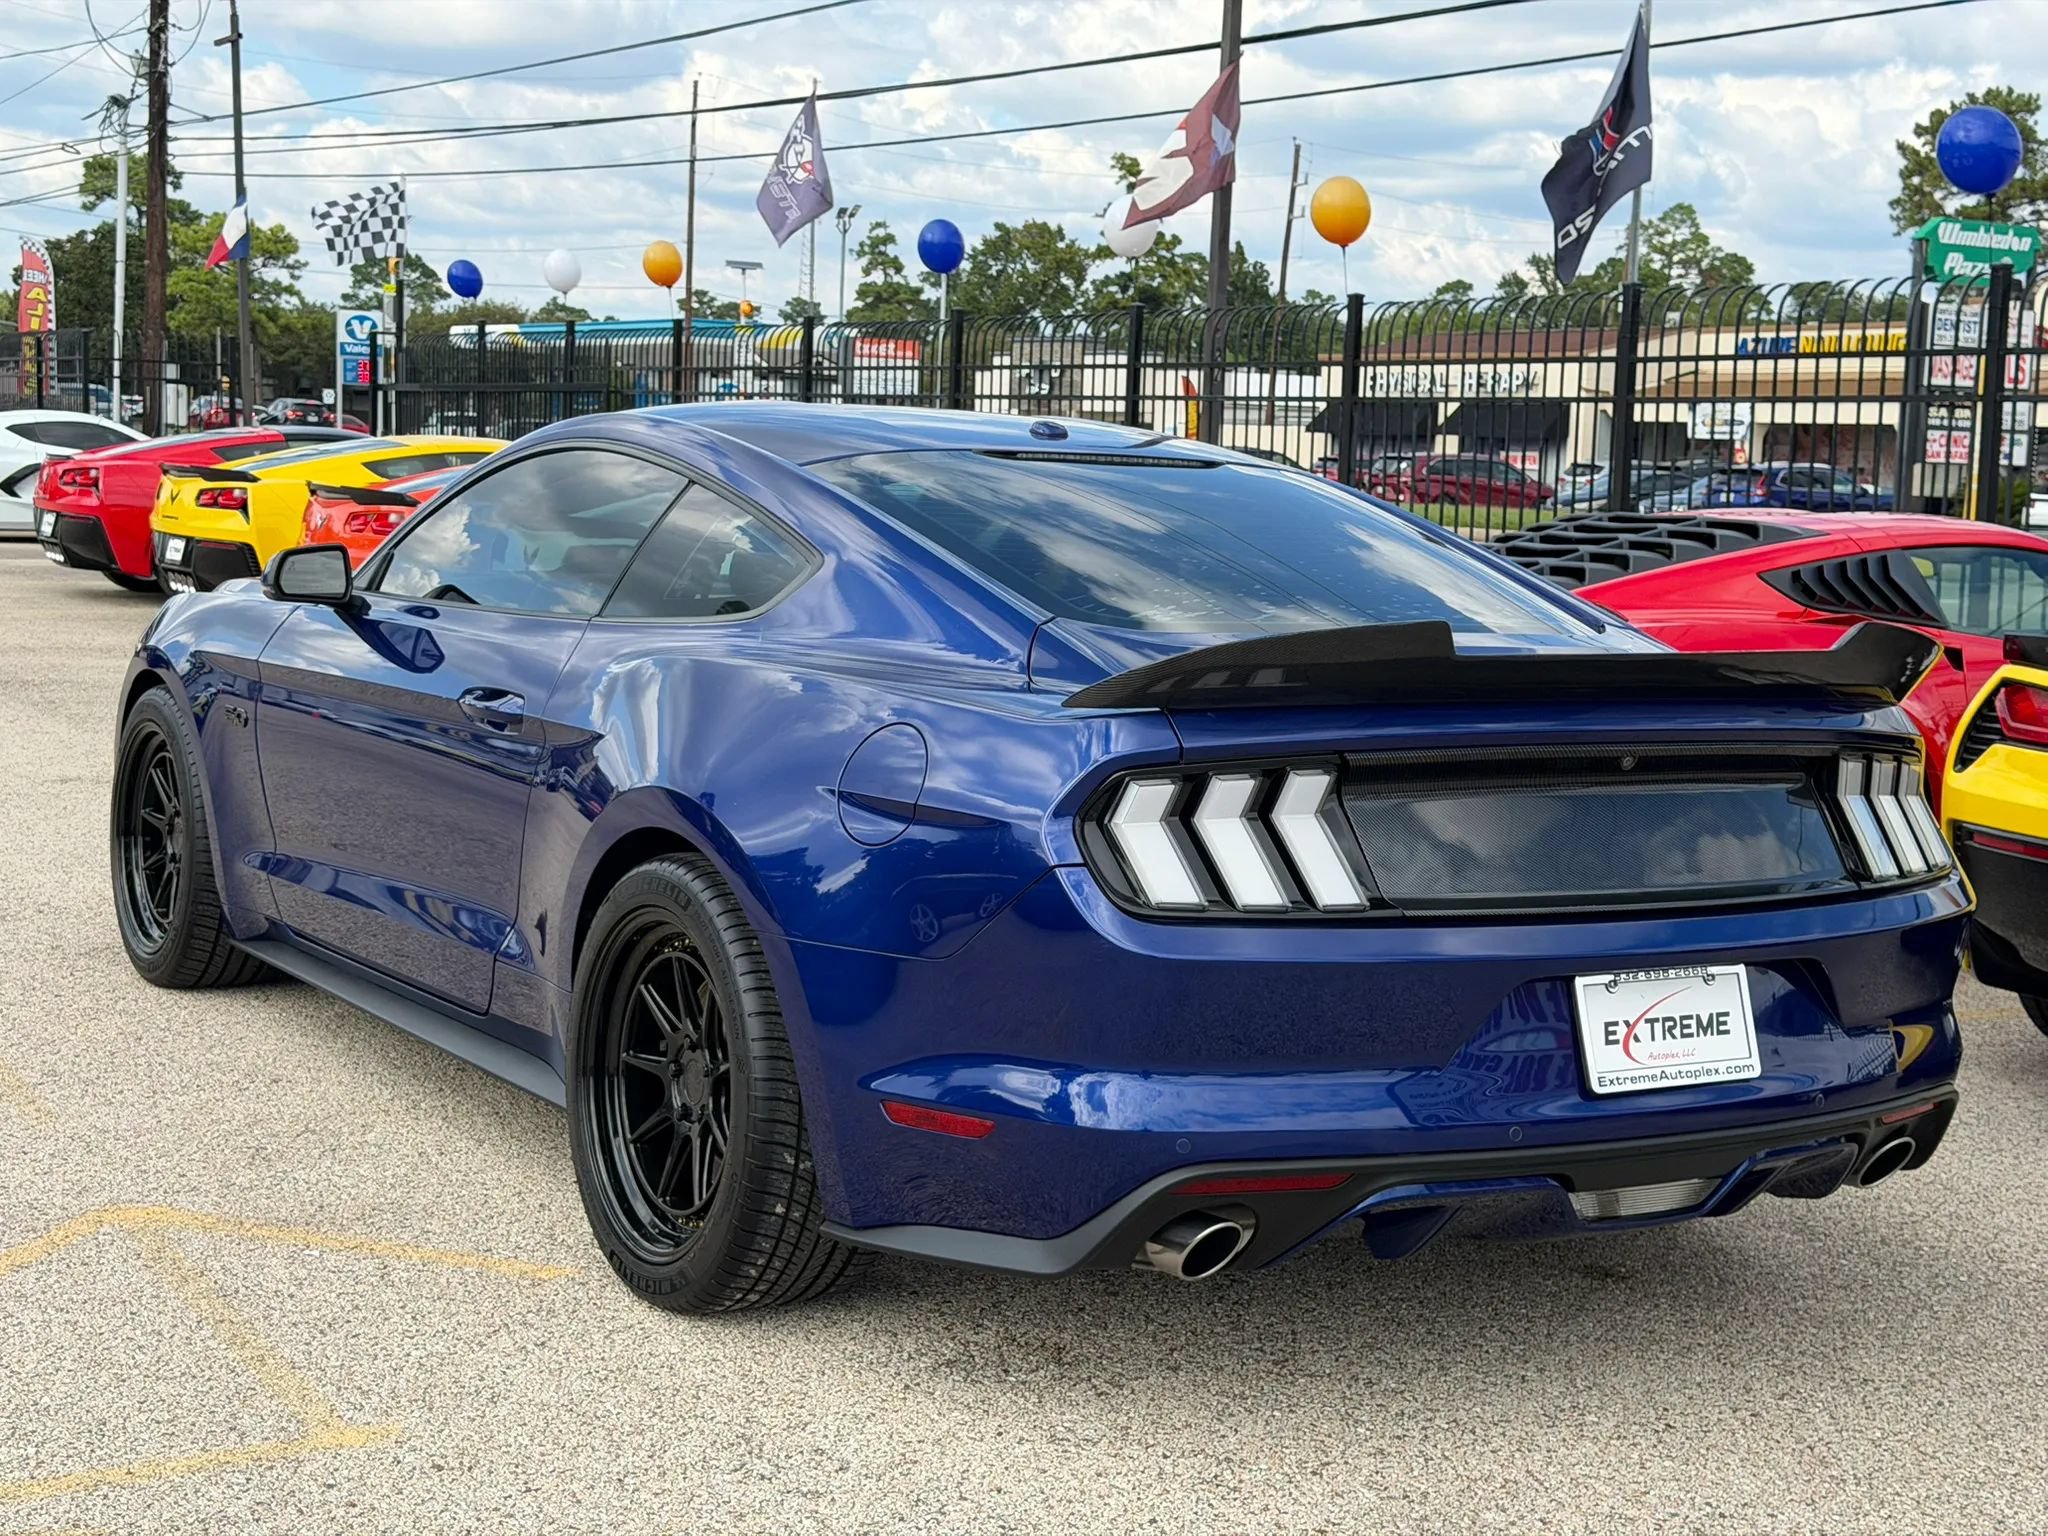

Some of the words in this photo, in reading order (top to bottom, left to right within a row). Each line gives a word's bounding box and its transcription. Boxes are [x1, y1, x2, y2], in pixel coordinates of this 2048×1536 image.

[1937, 221, 2032, 252] Wimbledon
[1937, 317, 1979, 335] DENIST
[1931, 354, 1976, 380] MASAGE
[1604, 1011, 1731, 1046] EXTREME
[1597, 1062, 1755, 1088] ExtremeAutoplex.com
